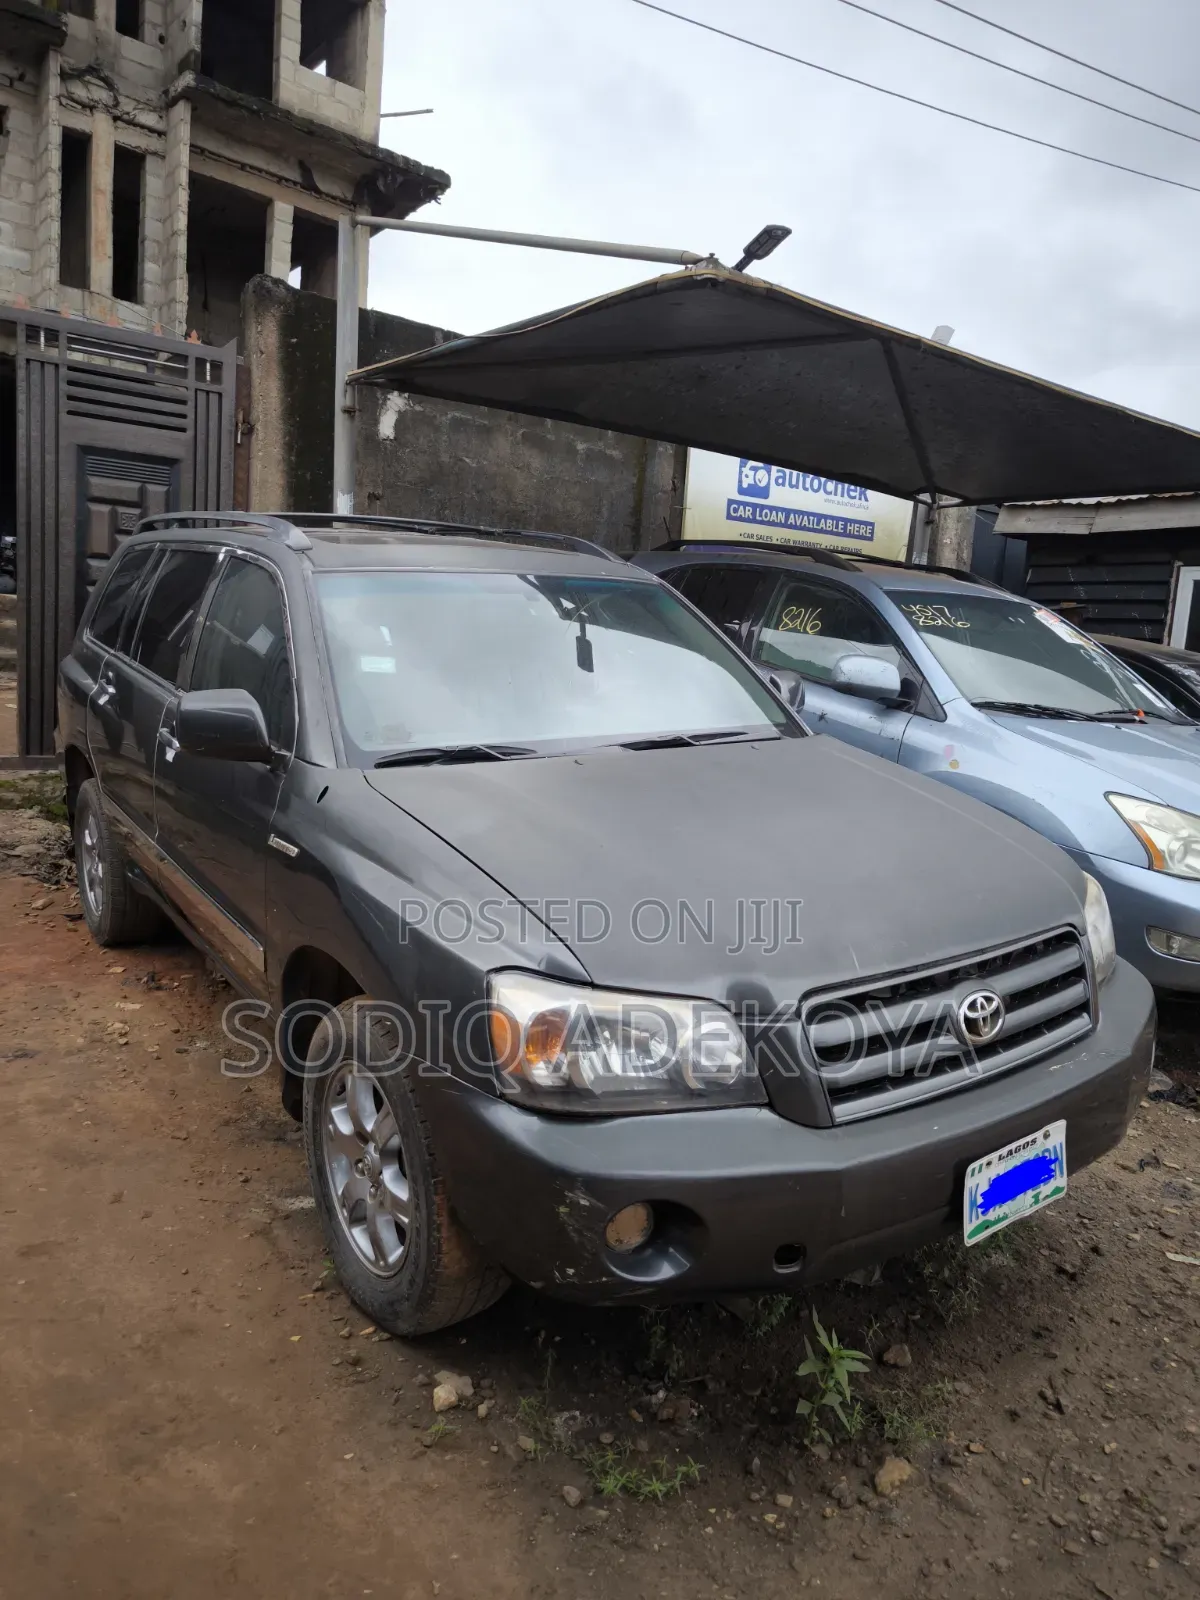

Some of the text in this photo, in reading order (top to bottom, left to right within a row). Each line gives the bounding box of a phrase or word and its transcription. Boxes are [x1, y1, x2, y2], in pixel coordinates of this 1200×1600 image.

[729, 504, 873, 537] CAR LOAN AVAILABLE HERE
[742, 532, 755, 540] CAR
[755, 534, 774, 543] SALES
[779, 537, 791, 545] CAR
[792, 539, 823, 549] WARRANTY
[997, 1137, 1038, 1162] LAGOS
